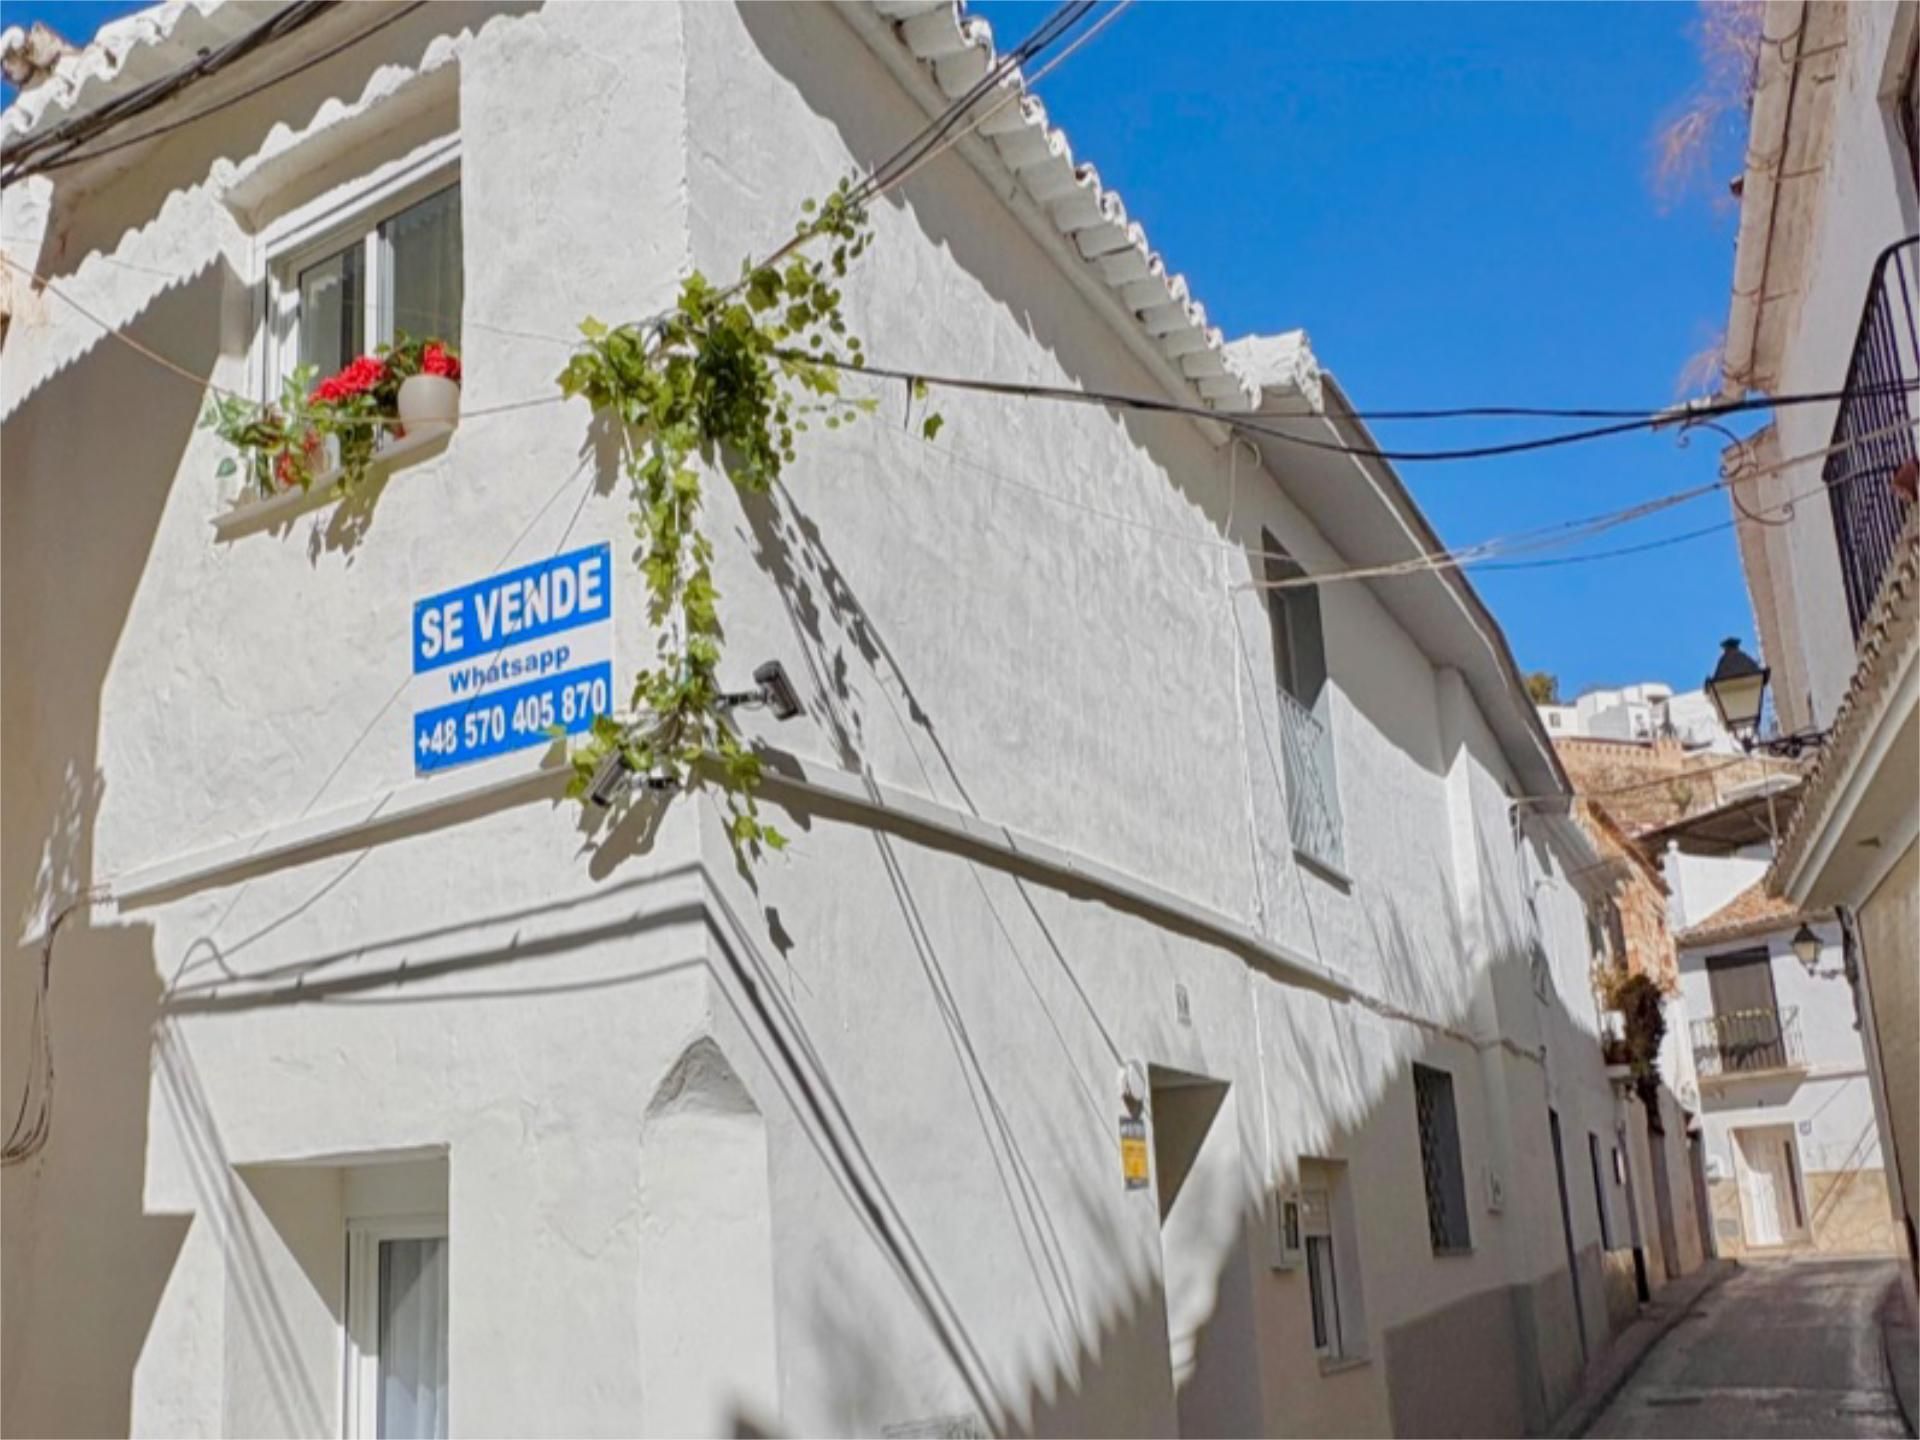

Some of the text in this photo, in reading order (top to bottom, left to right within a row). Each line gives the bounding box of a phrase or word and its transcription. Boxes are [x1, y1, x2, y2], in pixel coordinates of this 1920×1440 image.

[421, 557, 602, 659] SE VENDE
[449, 646, 570, 694] Whatsapp
[418, 678, 606, 756] +48 570 405 870
